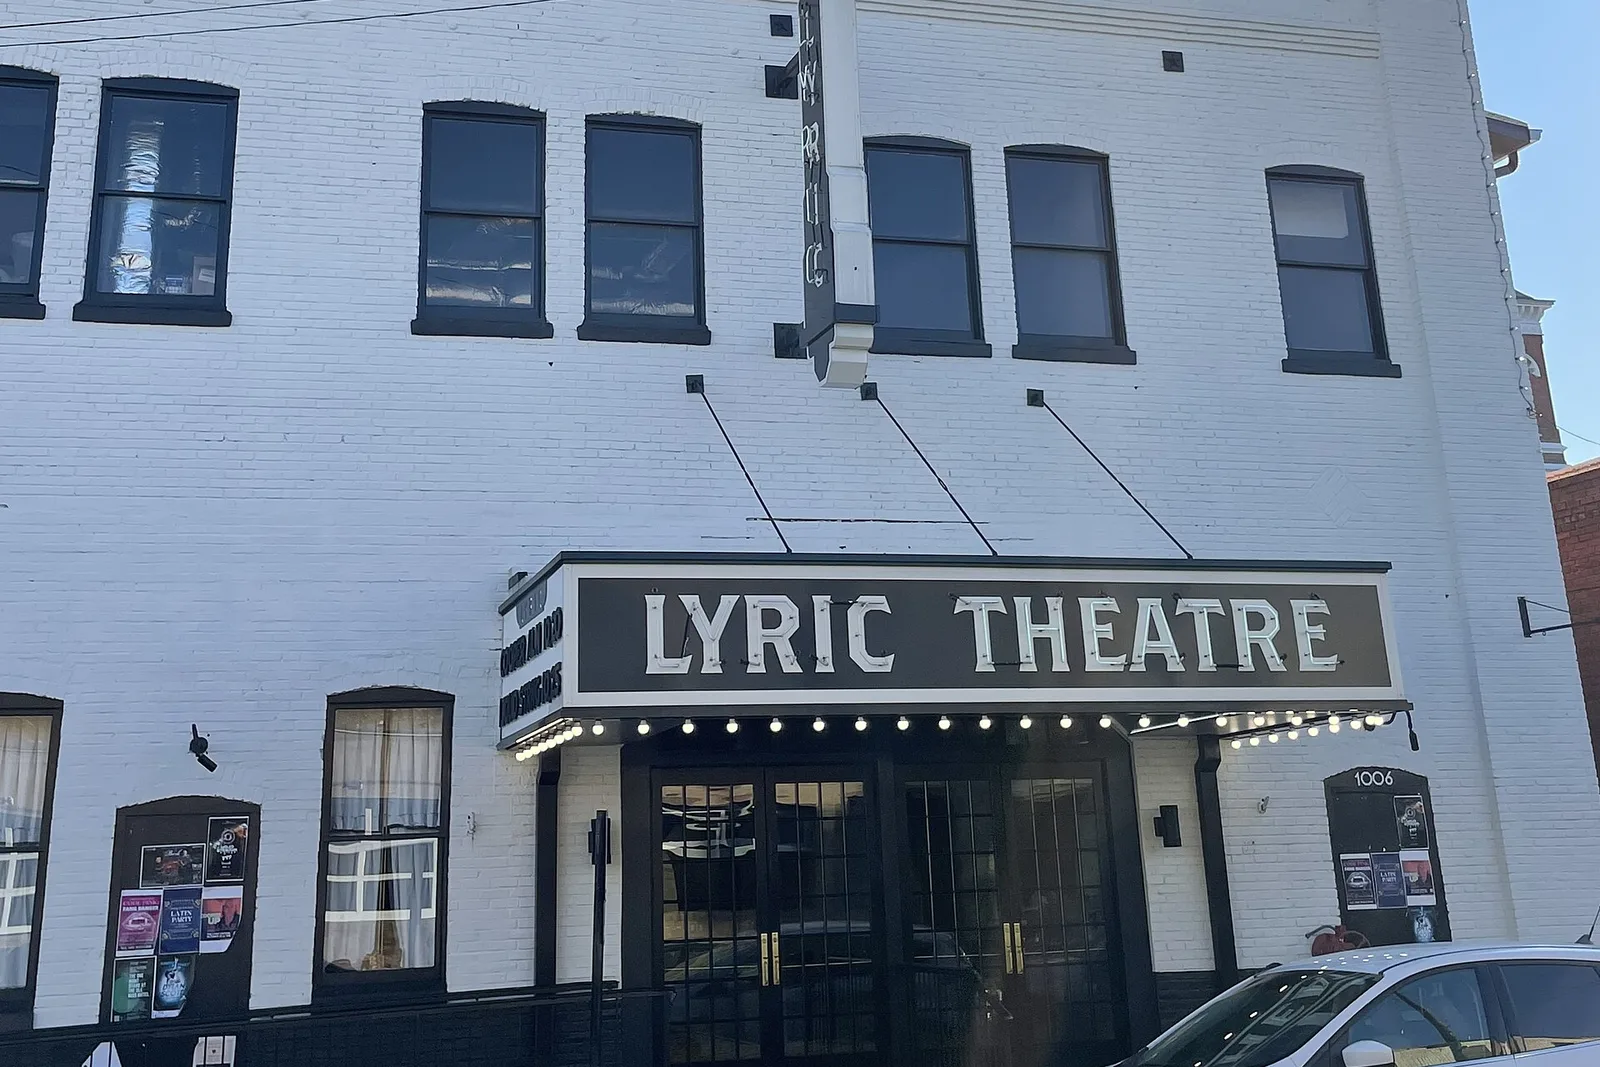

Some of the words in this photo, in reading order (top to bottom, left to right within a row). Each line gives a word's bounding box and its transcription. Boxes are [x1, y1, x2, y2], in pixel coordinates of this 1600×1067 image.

[644, 594, 895, 674] LYRIC
[953, 596, 1339, 672] THEATRE
[1354, 771, 1393, 786] 1006
[170, 909, 192, 917] LATIN
